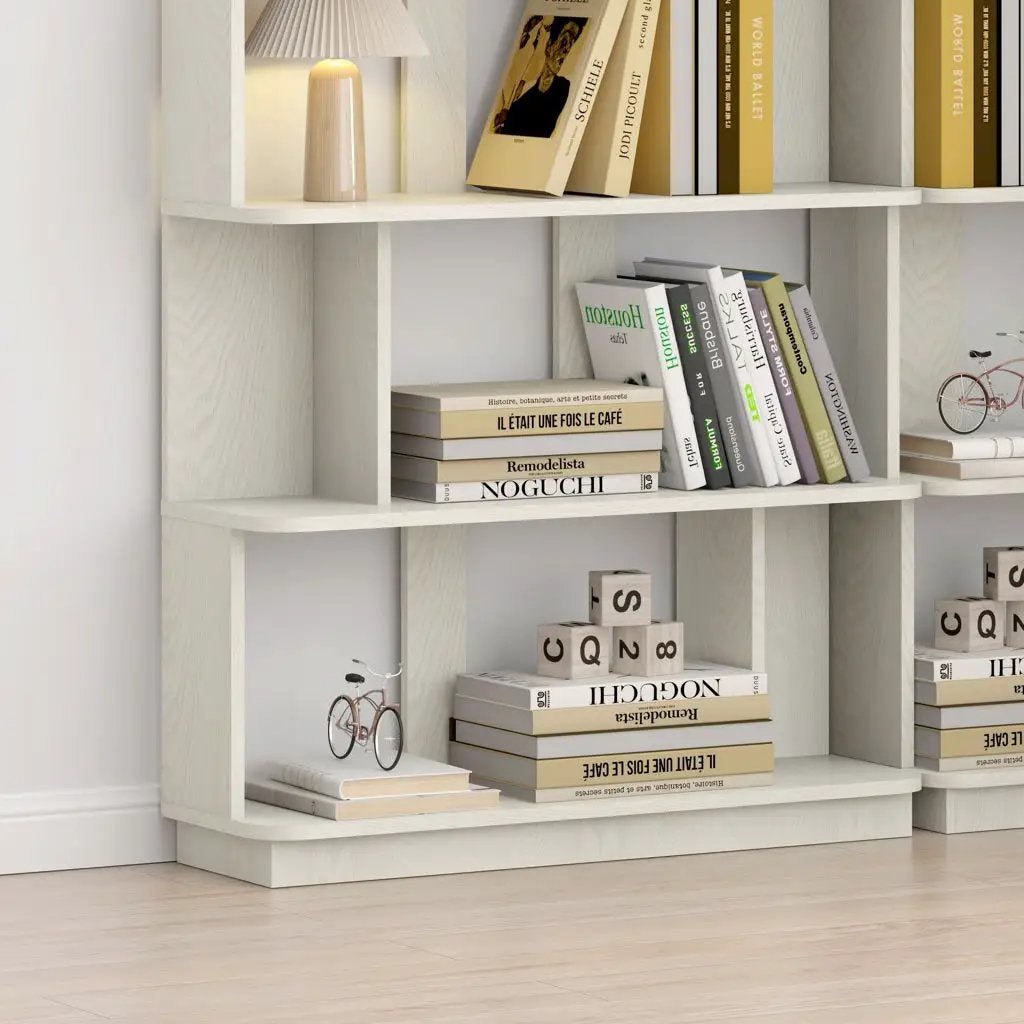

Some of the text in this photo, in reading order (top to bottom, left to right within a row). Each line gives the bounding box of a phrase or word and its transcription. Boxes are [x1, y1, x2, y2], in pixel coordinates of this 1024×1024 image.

[638, 14, 649, 49] second
[752, 16, 764, 122] WORLD BALLET
[575, 59, 604, 123] SCHIELE
[619, 71, 642, 160] JODI PICOULT
[488, 392, 628, 406] Histoire, botanique, arts et petits secrets
[497, 407, 623, 430] IL ÉTAIT UNE FOIS LE CAFÉ
[507, 457, 585, 474] Remodelista
[480, 475, 605, 500] NOGUCHI
[612, 589, 642, 613] S
[977, 609, 997, 639] Q
[579, 635, 601, 666] Q
[590, 678, 721, 705] NOGUCHI
[615, 708, 698, 724] Remodelista
[583, 754, 716, 781] IL ÉTAIT UNE FOIS LE CAFÉ
